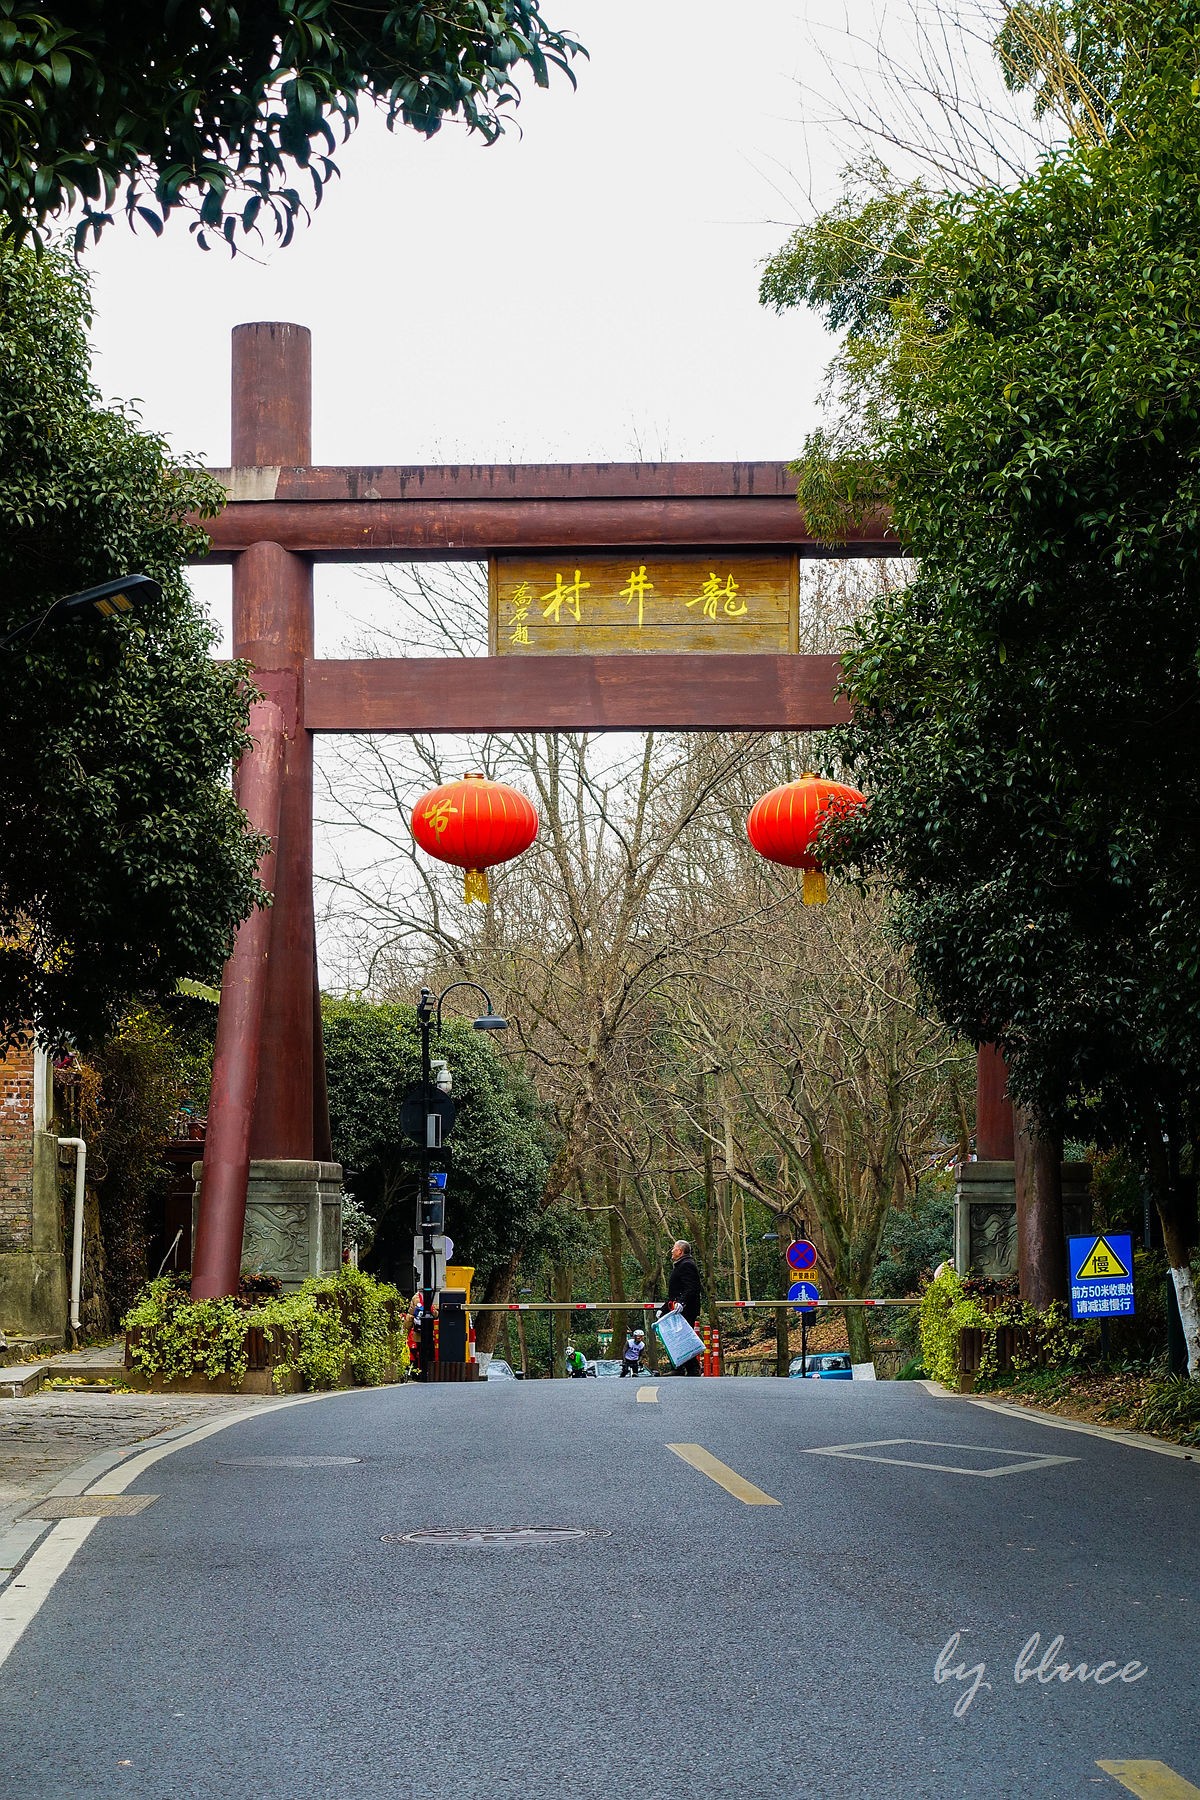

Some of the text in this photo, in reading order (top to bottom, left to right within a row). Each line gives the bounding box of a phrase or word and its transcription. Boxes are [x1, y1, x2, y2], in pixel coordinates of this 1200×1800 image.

[1092, 1255, 1109, 1273] 慢
[1071, 1283, 1134, 1299] 前方50米收费处
[1077, 1298, 1131, 1313] 请减速慢行
